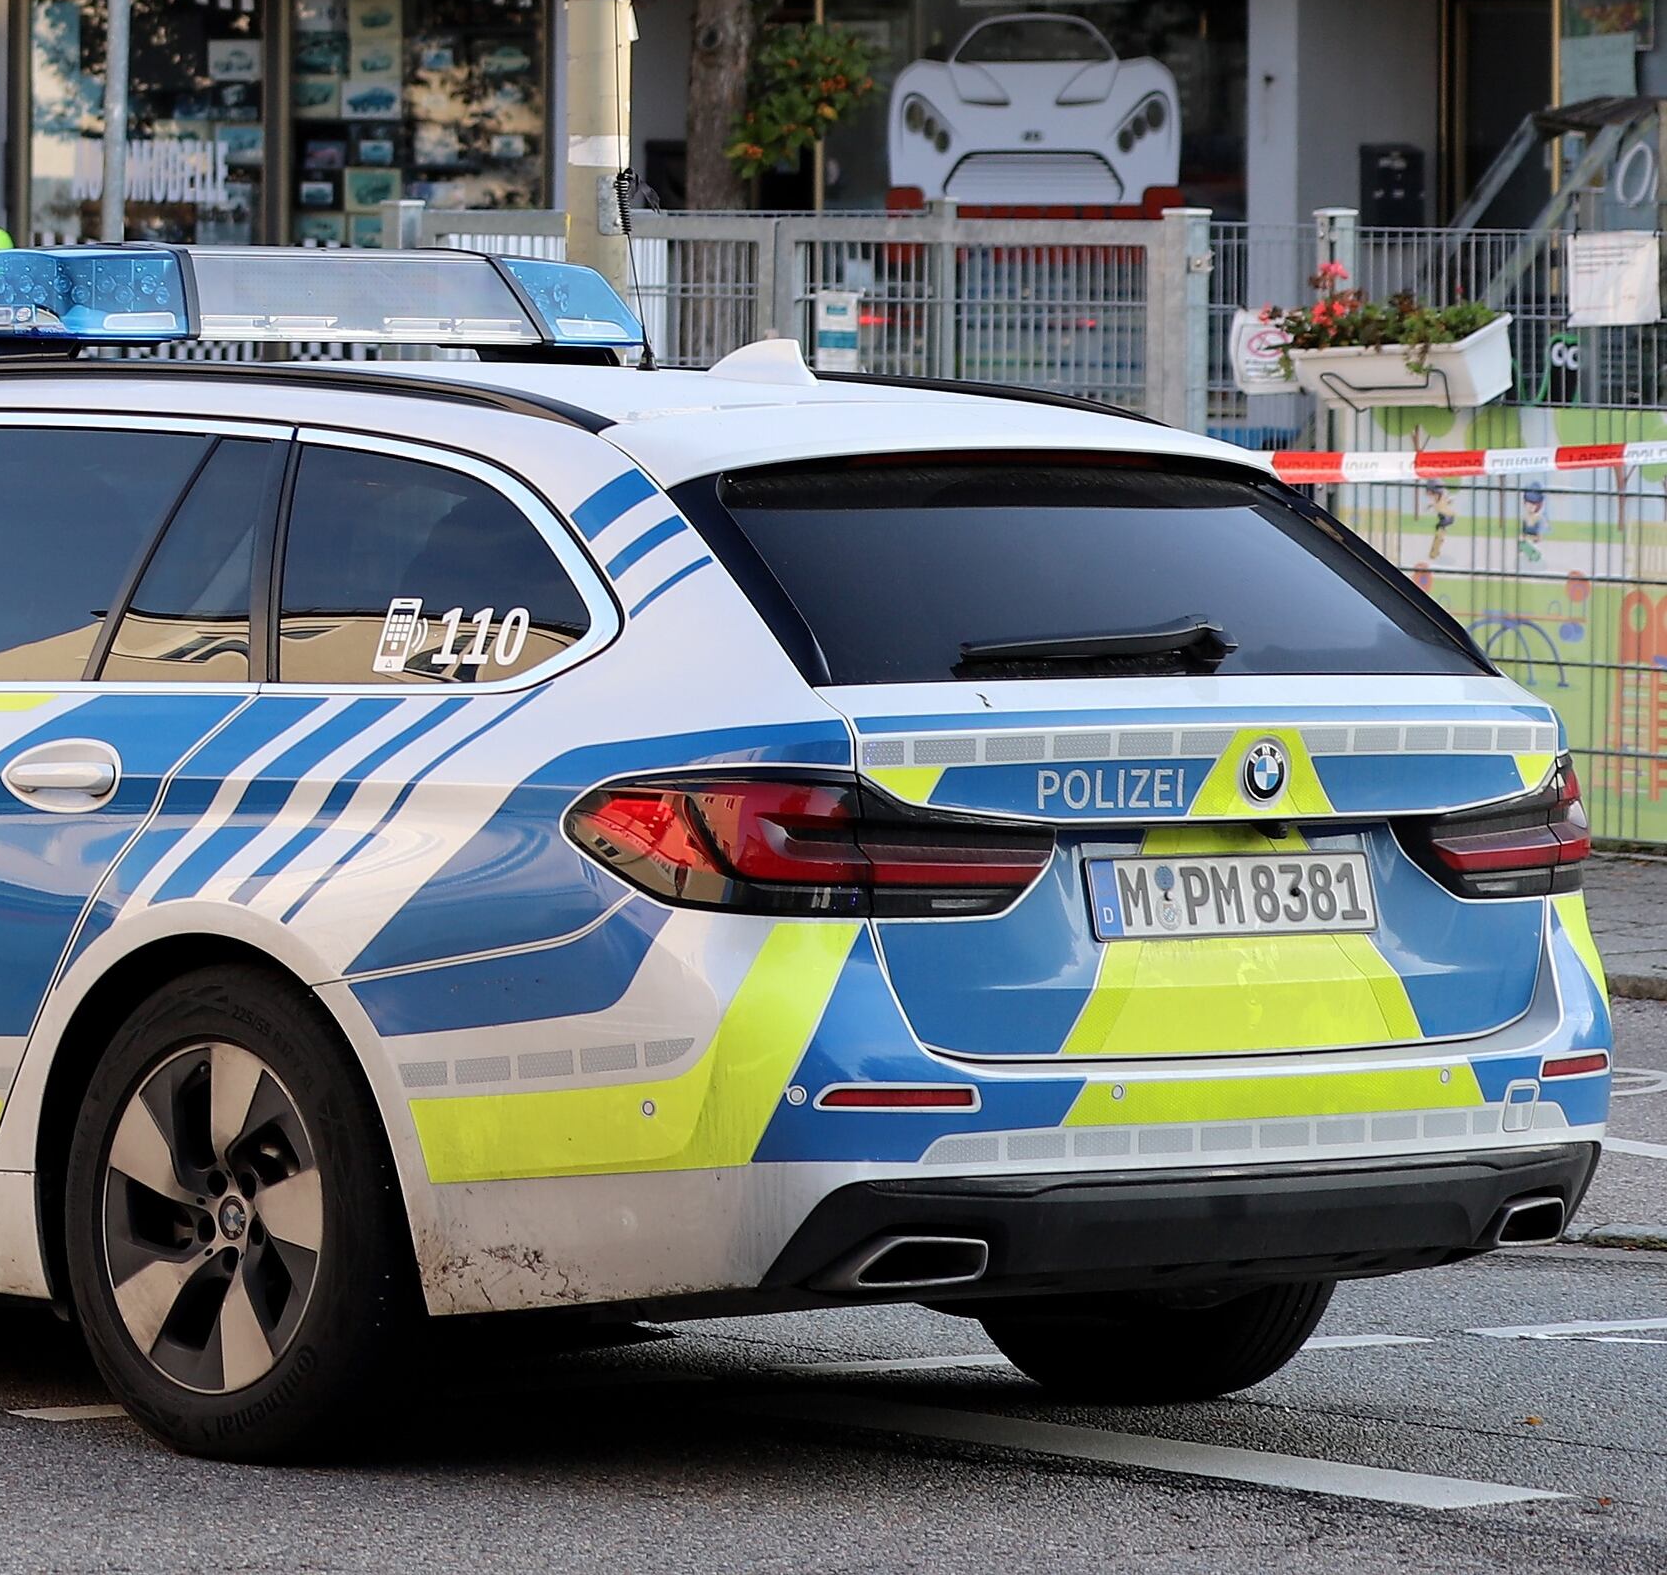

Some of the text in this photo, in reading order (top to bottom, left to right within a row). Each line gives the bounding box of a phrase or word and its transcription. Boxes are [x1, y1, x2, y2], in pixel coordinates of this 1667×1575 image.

[71, 139, 229, 202] AUMODELLE
[430, 606, 529, 666] 110
[1037, 767, 1187, 810] POLIZEI
[1104, 908, 1114, 923] D
[1119, 864, 1367, 927] M PM 8381
